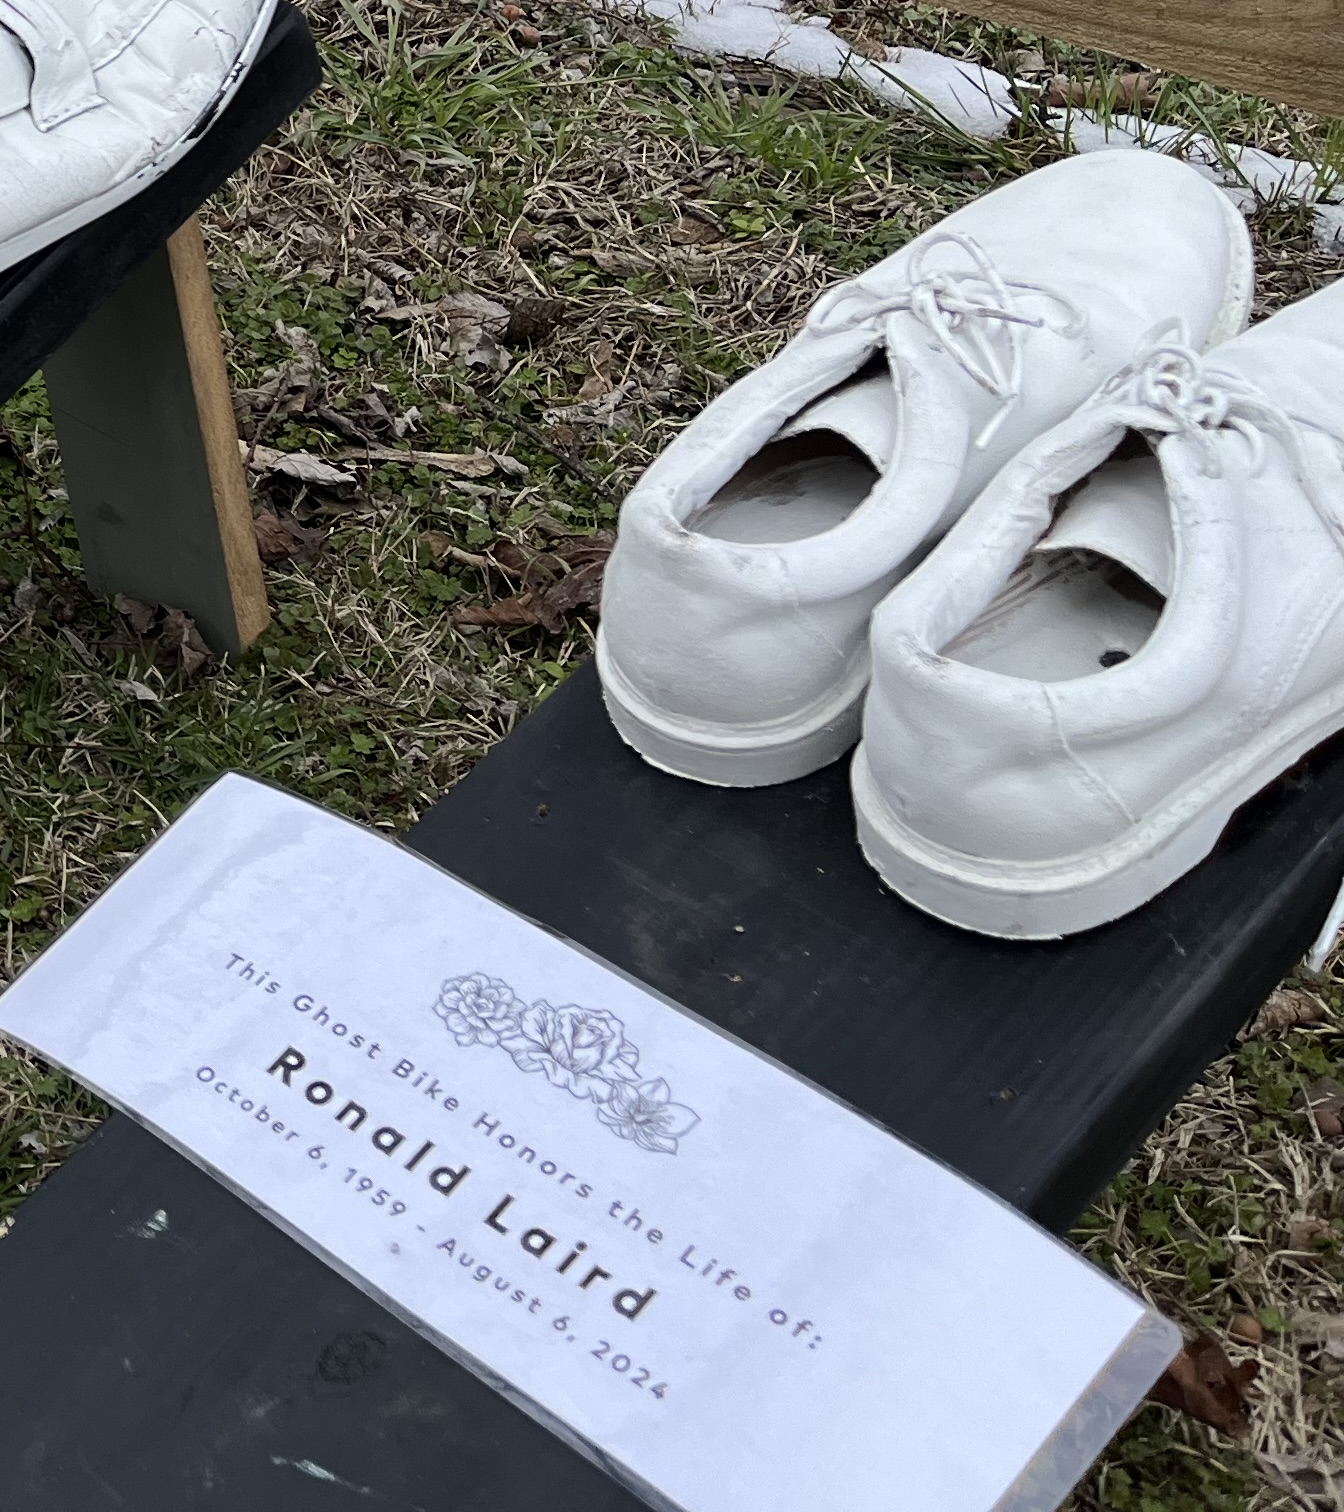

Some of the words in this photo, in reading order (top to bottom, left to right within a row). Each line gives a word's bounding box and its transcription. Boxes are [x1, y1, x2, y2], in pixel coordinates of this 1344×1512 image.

[196, 1066, 300, 1142] October
[307, 1144, 329, 1170] 6,
[343, 1167, 407, 1217] 1959
[437, 1237, 543, 1316] August
[552, 1315, 576, 1343] 6,
[590, 1340, 670, 1400] 2024
[225, 952, 281, 994] This
[292, 994, 382, 1060] Ghost
[392, 1059, 459, 1111] Bike
[473, 1111, 594, 1199] Honors
[608, 1199, 664, 1245] the
[679, 1245, 752, 1302] Life
[768, 1308, 822, 1350] of:
[266, 1045, 472, 1198] Ronald
[482, 1193, 658, 1322] Laird
